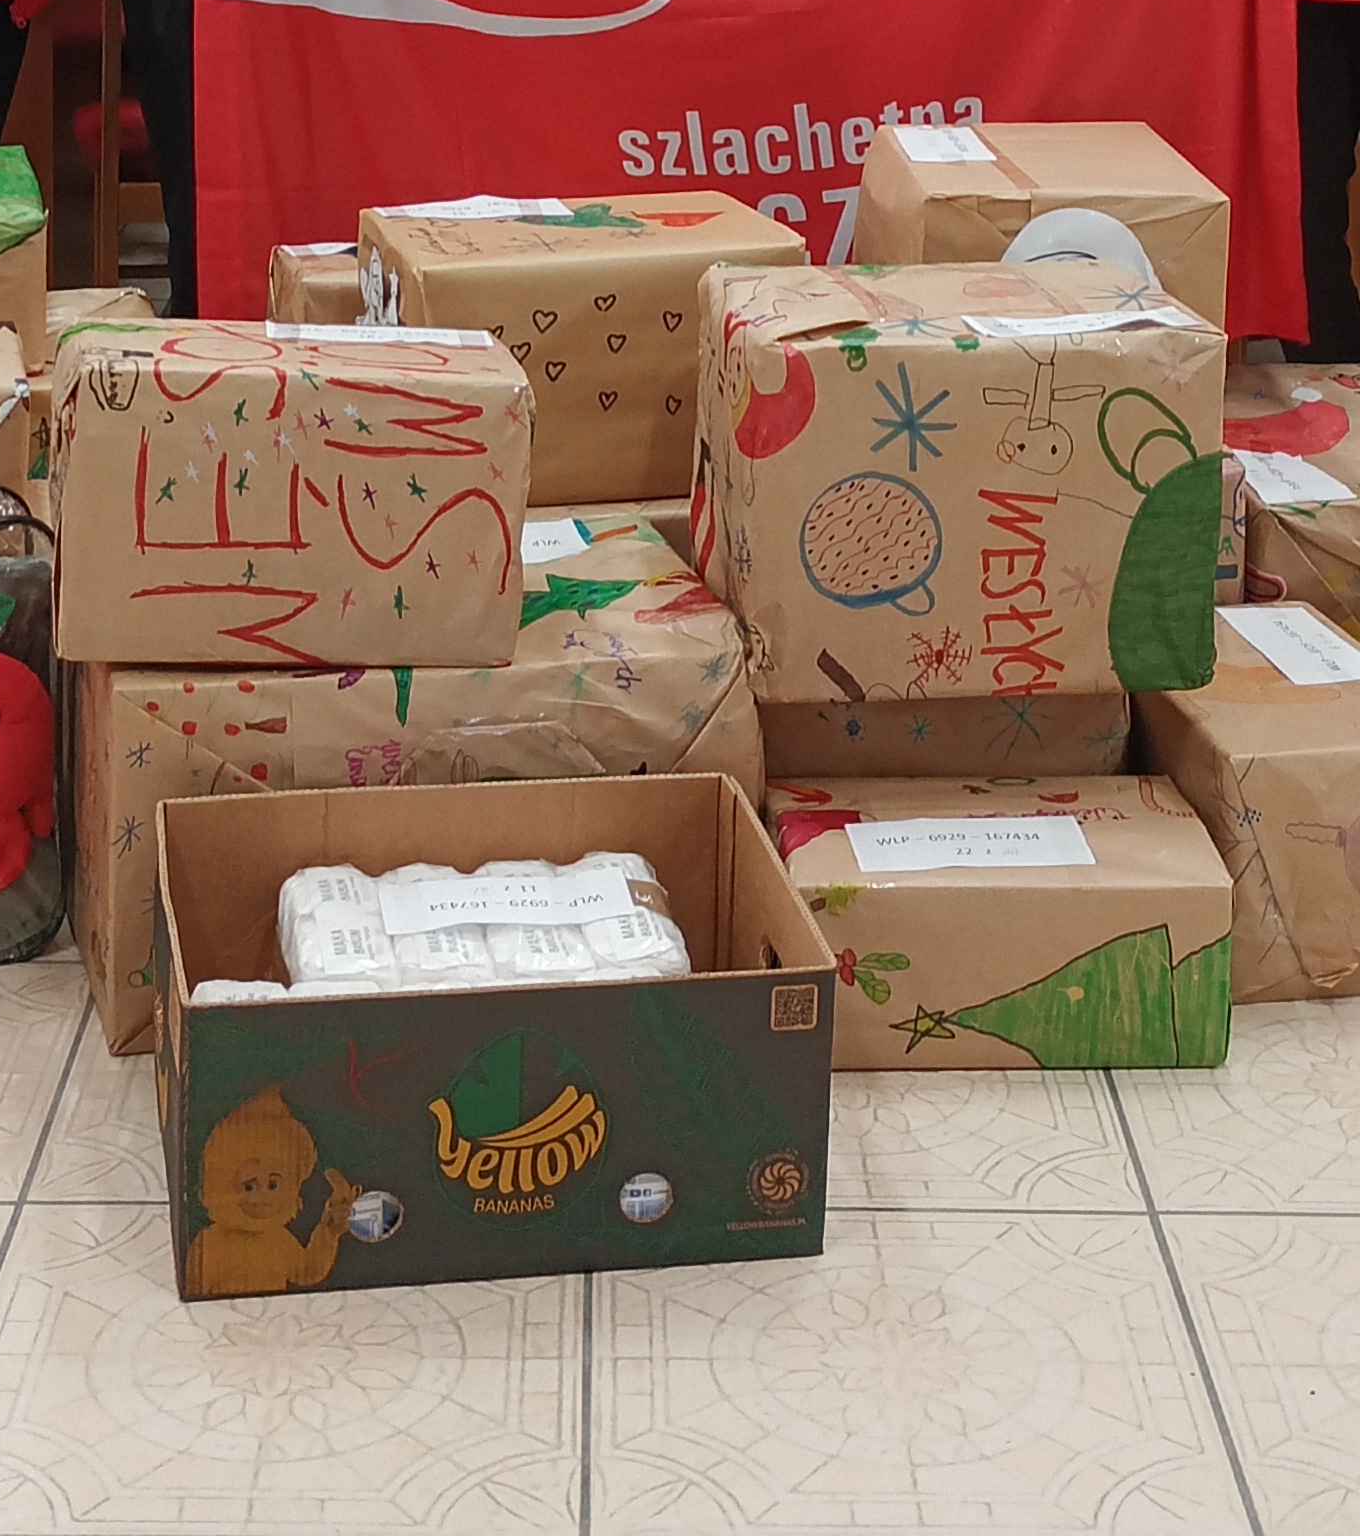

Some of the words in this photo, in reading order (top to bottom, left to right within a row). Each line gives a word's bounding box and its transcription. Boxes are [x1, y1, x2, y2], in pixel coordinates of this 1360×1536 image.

[875, 835, 910, 847] WLP
[928, 832, 966, 842] 6929
[984, 831, 1040, 842] 167434
[955, 847, 974, 856] 22
[521, 885, 537, 893] 11
[509, 898, 549, 907] 6929
[568, 893, 604, 907] WLP
[429, 901, 489, 912] 167434
[473, 1194, 555, 1214] BANANAS
